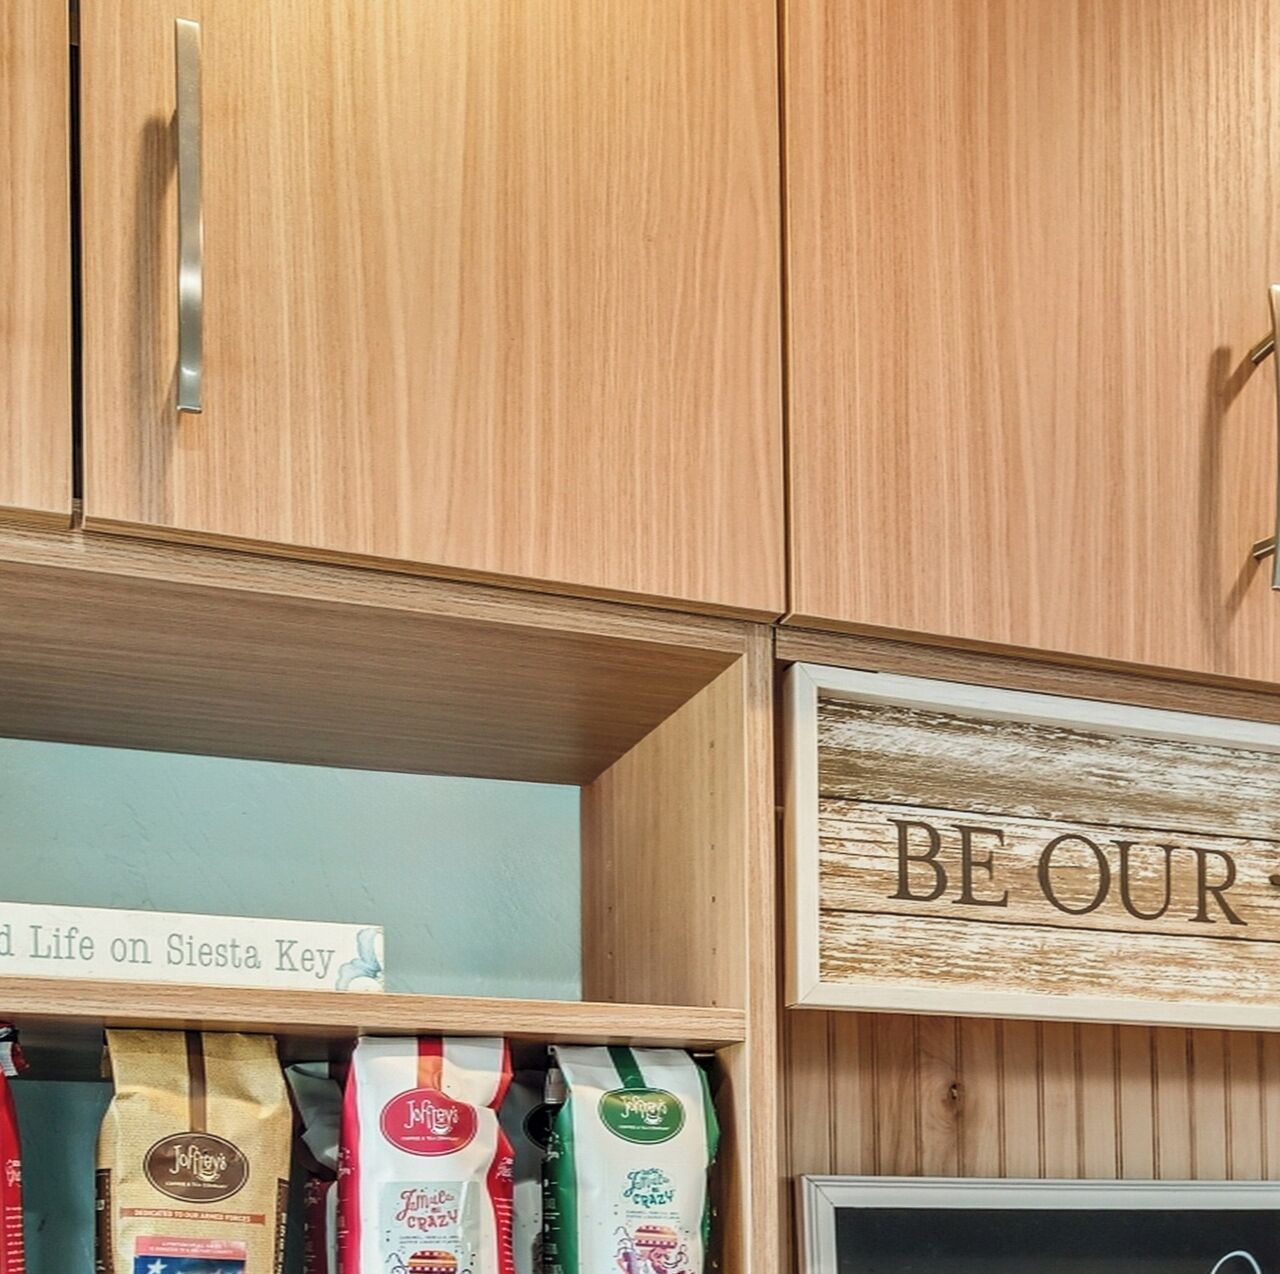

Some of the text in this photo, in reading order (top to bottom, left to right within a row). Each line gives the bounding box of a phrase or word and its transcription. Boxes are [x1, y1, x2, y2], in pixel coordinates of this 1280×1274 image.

[888, 817, 1010, 908] BE
[1038, 833, 1250, 926] OUR
[29, 924, 95, 962] Life
[110, 936, 152, 965] on
[167, 932, 262, 970] Siesta
[275, 938, 336, 980] Key
